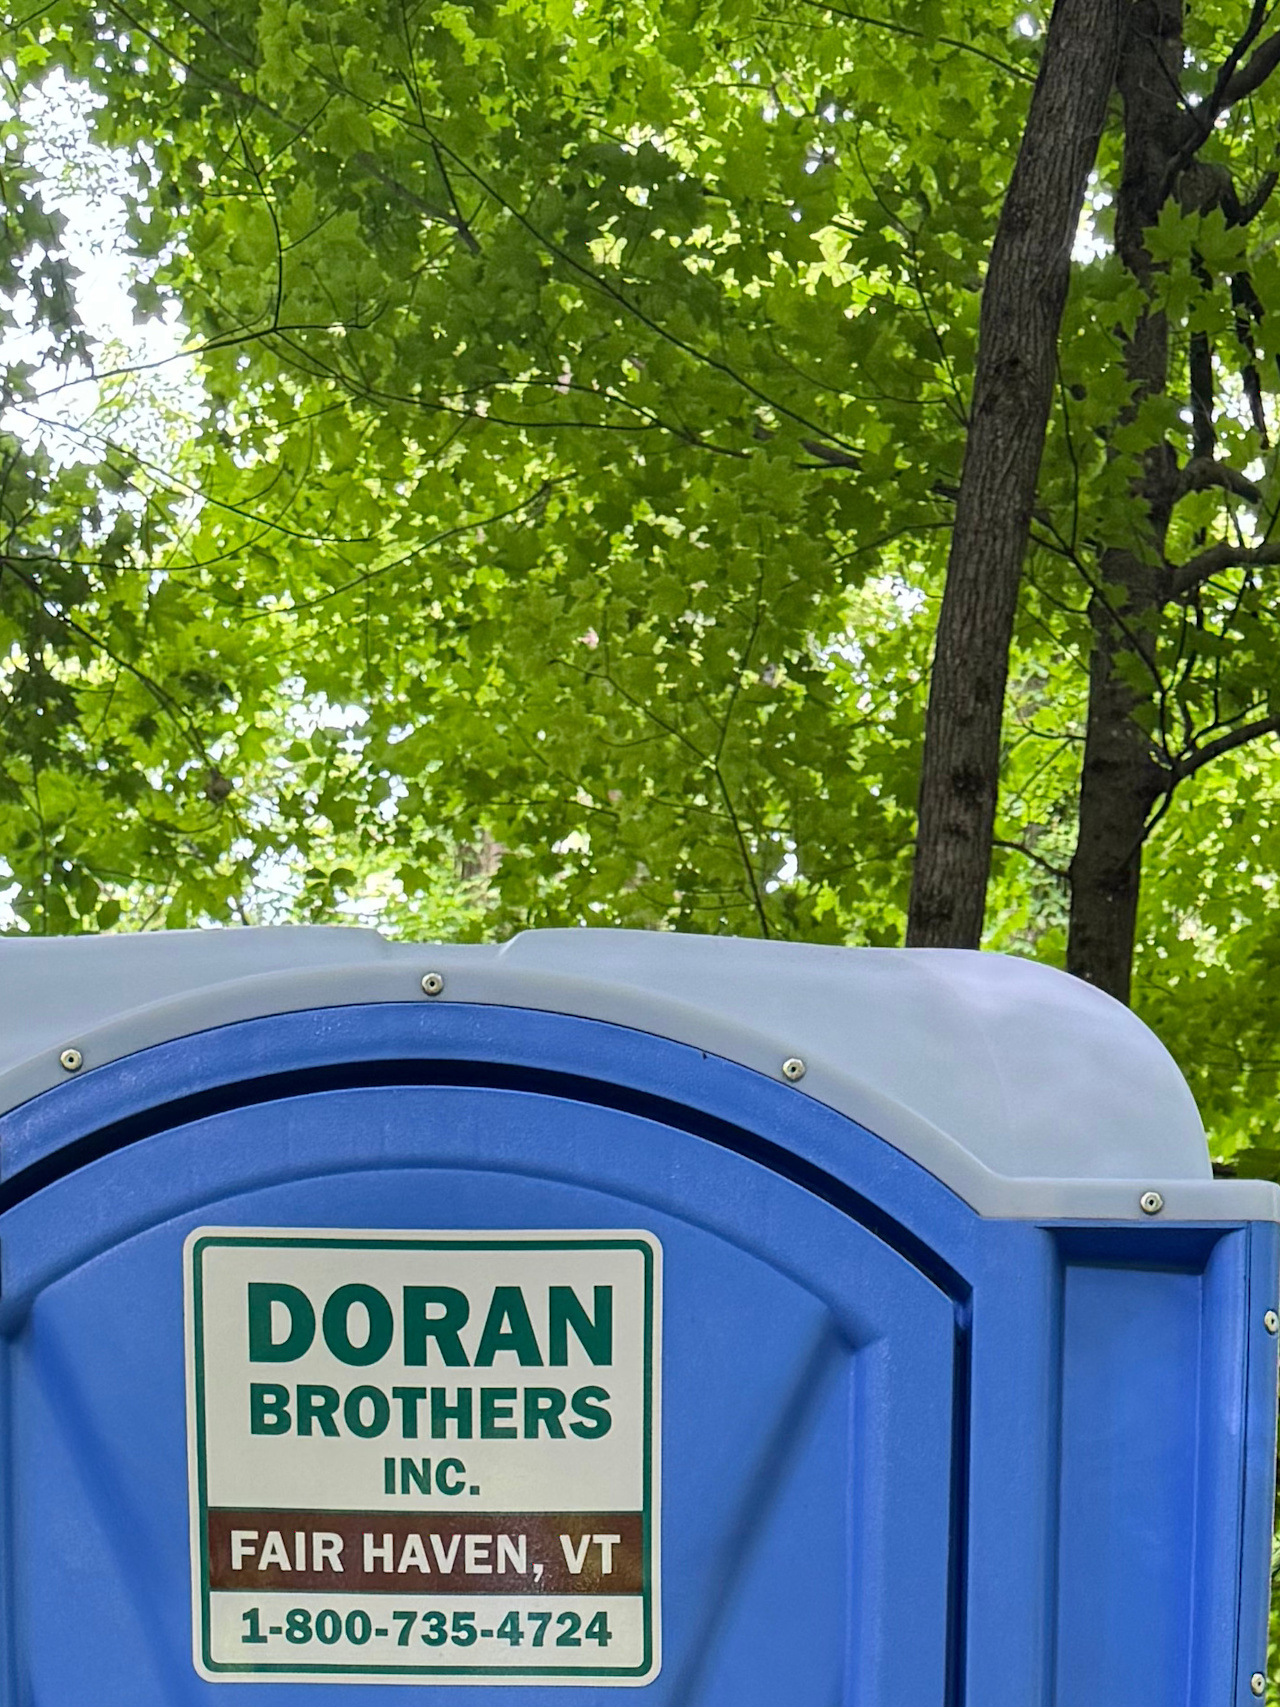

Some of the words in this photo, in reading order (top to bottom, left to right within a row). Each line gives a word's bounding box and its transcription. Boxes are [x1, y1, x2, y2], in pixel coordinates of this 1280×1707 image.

[247, 1282, 613, 1367] DORAN
[250, 1382, 613, 1440] BROTHERS
[383, 1457, 480, 1496] INC.
[230, 1530, 345, 1573] FAIR
[363, 1532, 544, 1583] HAVEN,
[559, 1534, 621, 1575] VT
[240, 1607, 613, 1648] 1-800-735-4724
